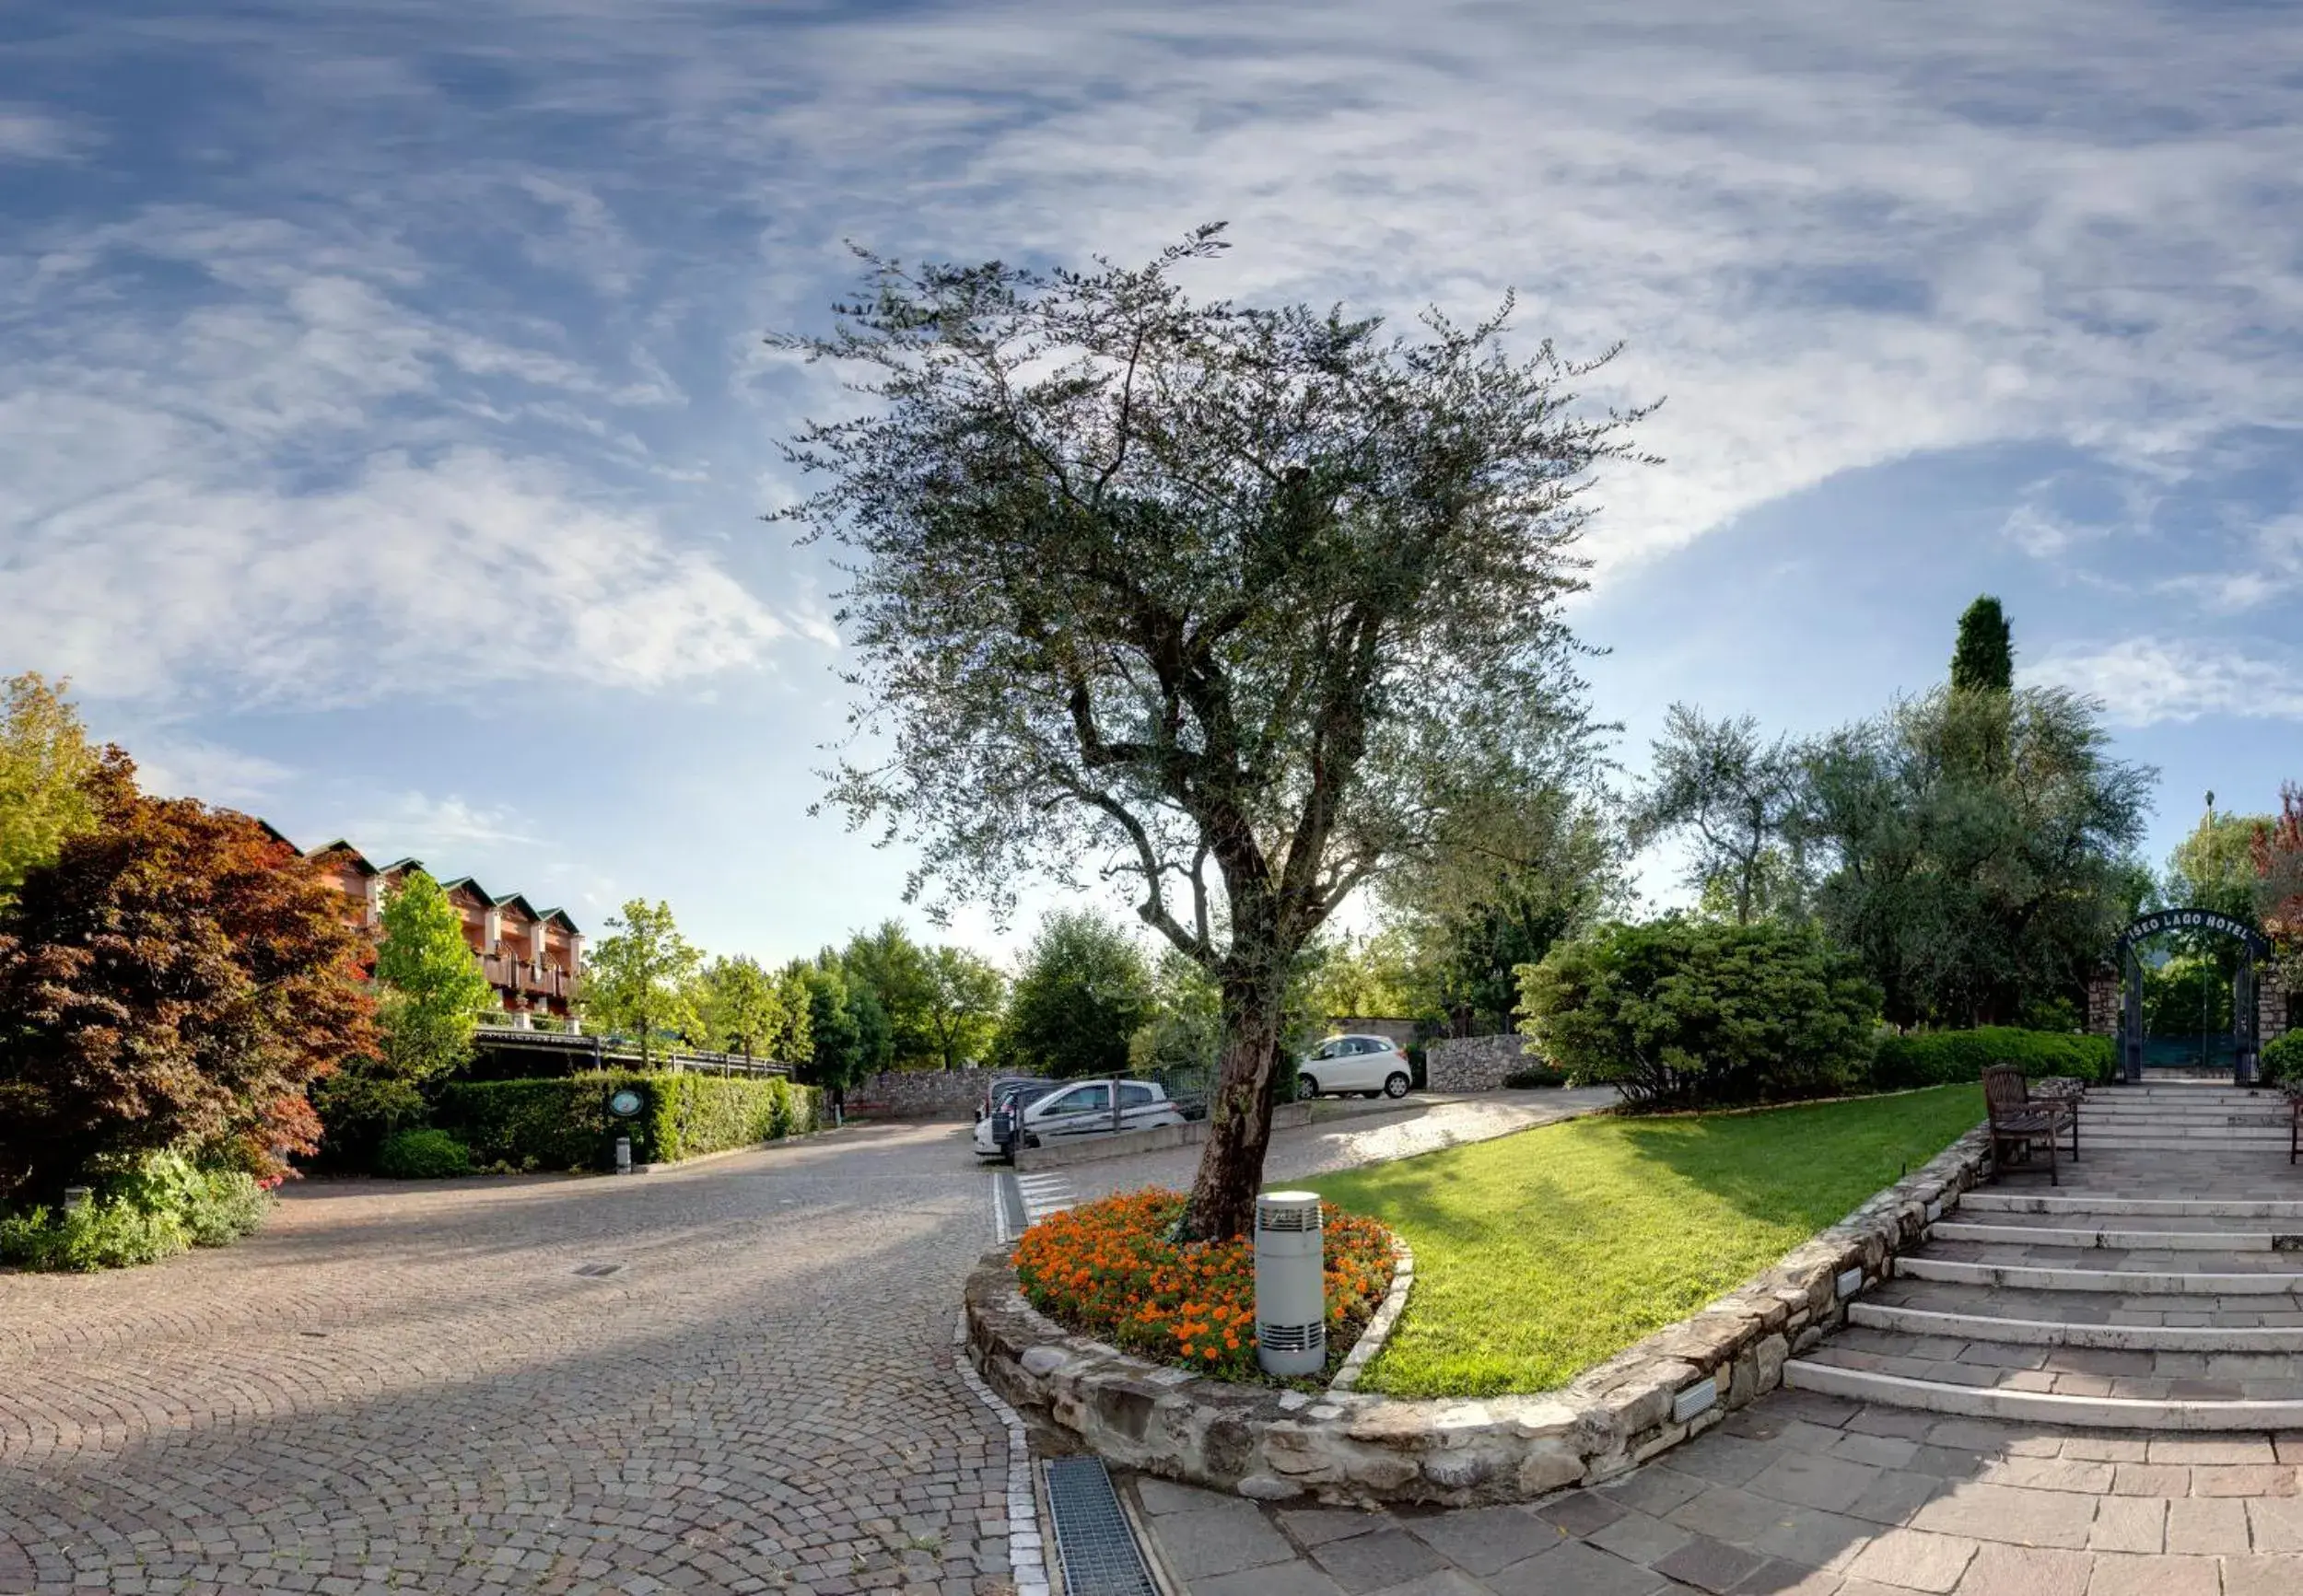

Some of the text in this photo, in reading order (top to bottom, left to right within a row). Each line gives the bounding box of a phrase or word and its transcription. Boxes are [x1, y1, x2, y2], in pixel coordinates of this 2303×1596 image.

[2128, 914, 2248, 939] ISEO LAGO HOTEL
